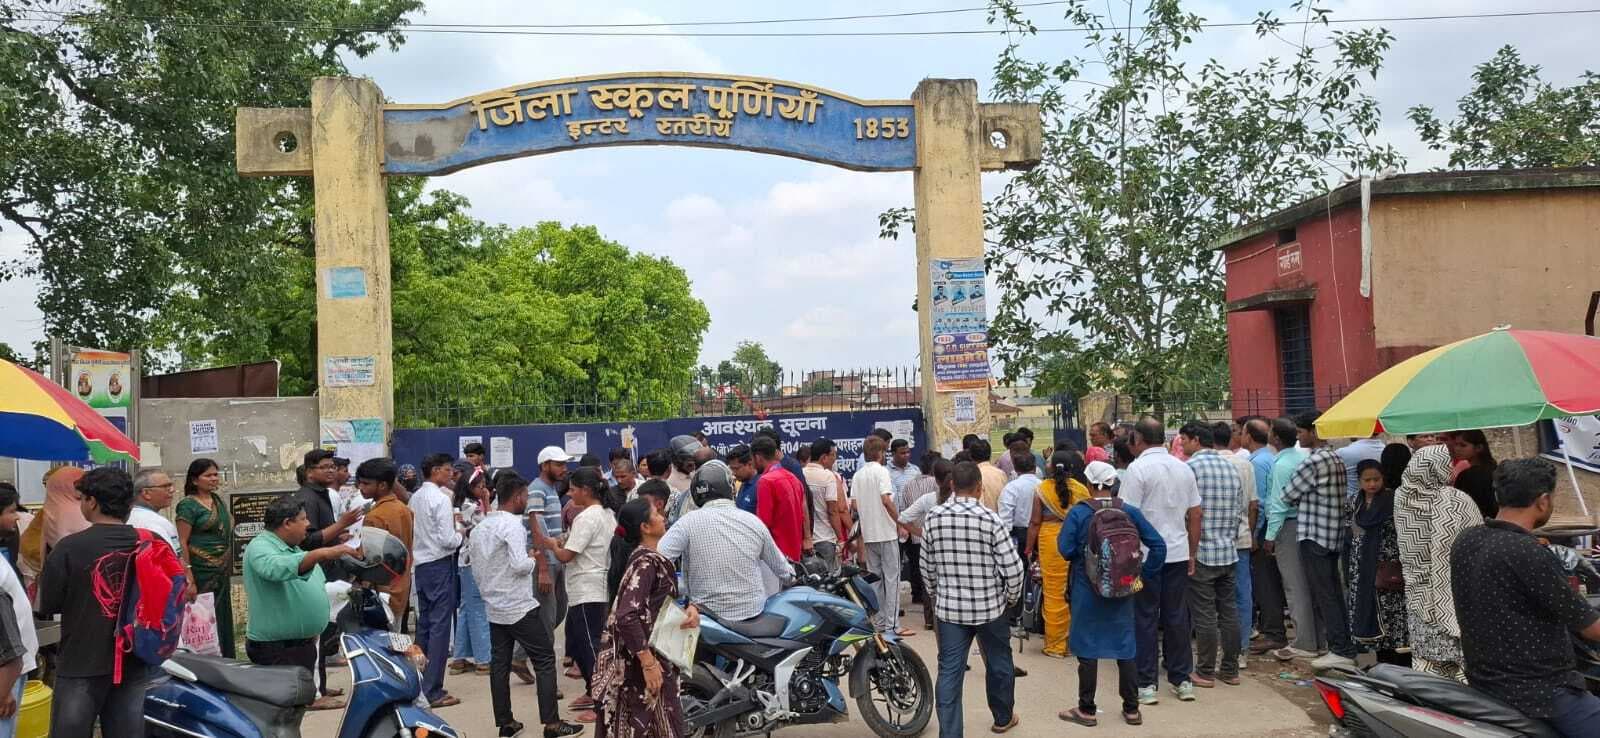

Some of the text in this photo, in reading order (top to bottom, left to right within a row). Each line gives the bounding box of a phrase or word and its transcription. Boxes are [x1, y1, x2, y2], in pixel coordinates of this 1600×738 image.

[470, 88, 578, 131] जिला
[588, 83, 697, 119] स्कूल
[566, 113, 733, 141] इन्टर स्तरीय
[853, 117, 911, 140] 1853
[701, 416, 828, 438] आवश्यक सूचना
